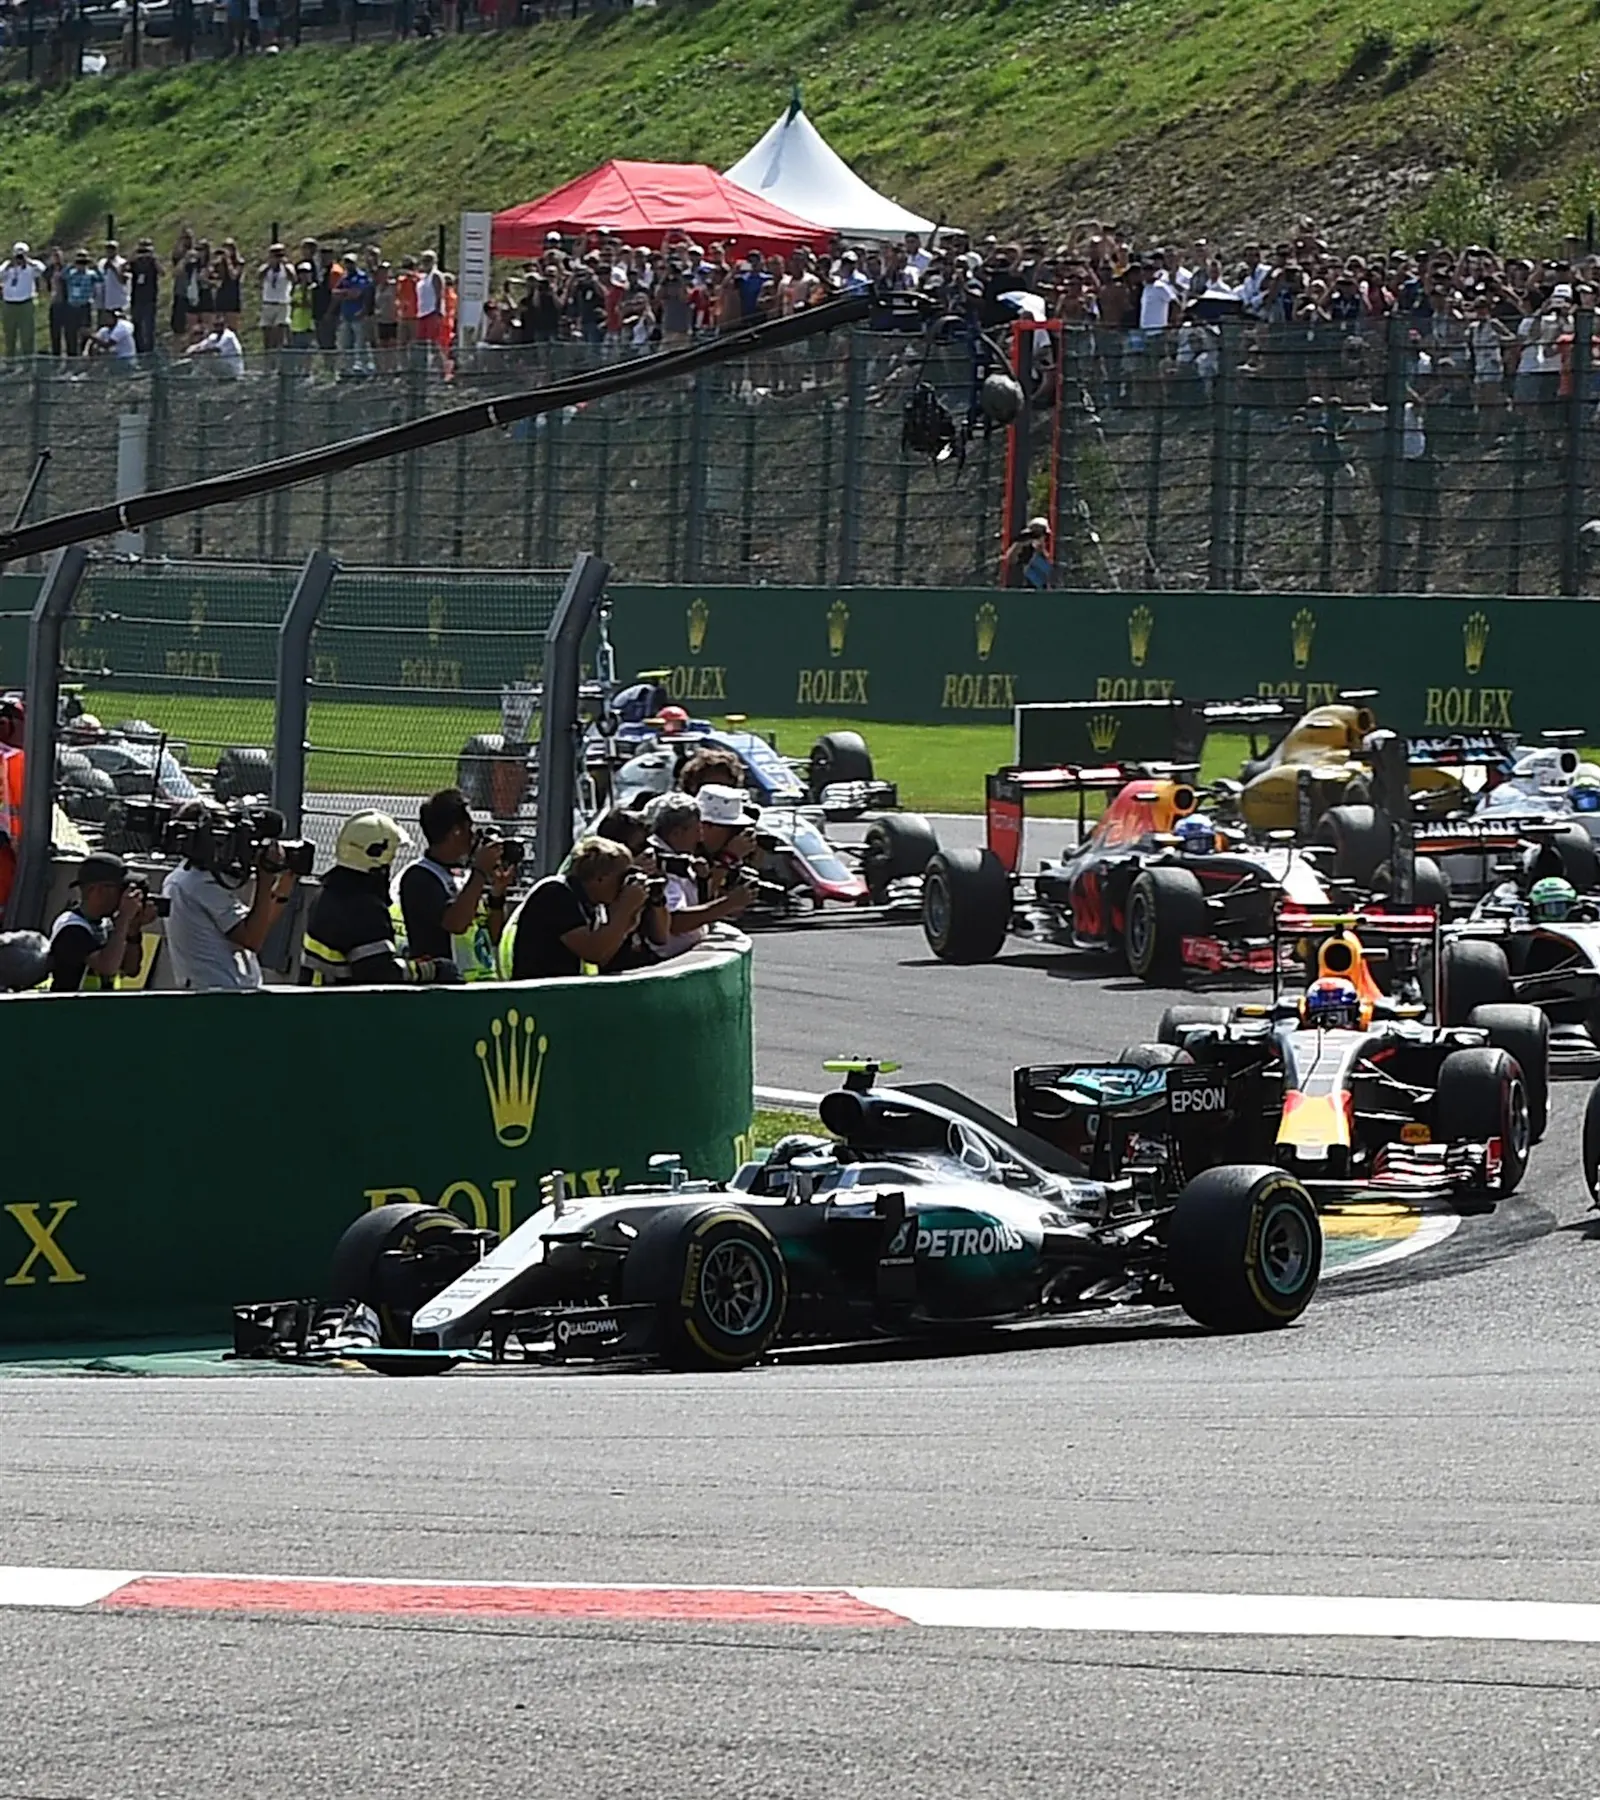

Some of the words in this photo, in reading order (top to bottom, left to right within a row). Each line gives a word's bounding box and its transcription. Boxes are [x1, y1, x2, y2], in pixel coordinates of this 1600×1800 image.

[797, 669, 869, 704] ROLEX
[941, 674, 1018, 709] ROLEX
[1424, 688, 1513, 728] ROLEX
[1171, 1087, 1226, 1113] EPSON
[3, 1200, 87, 1285] X
[915, 1225, 1024, 1258] PETRONAS
